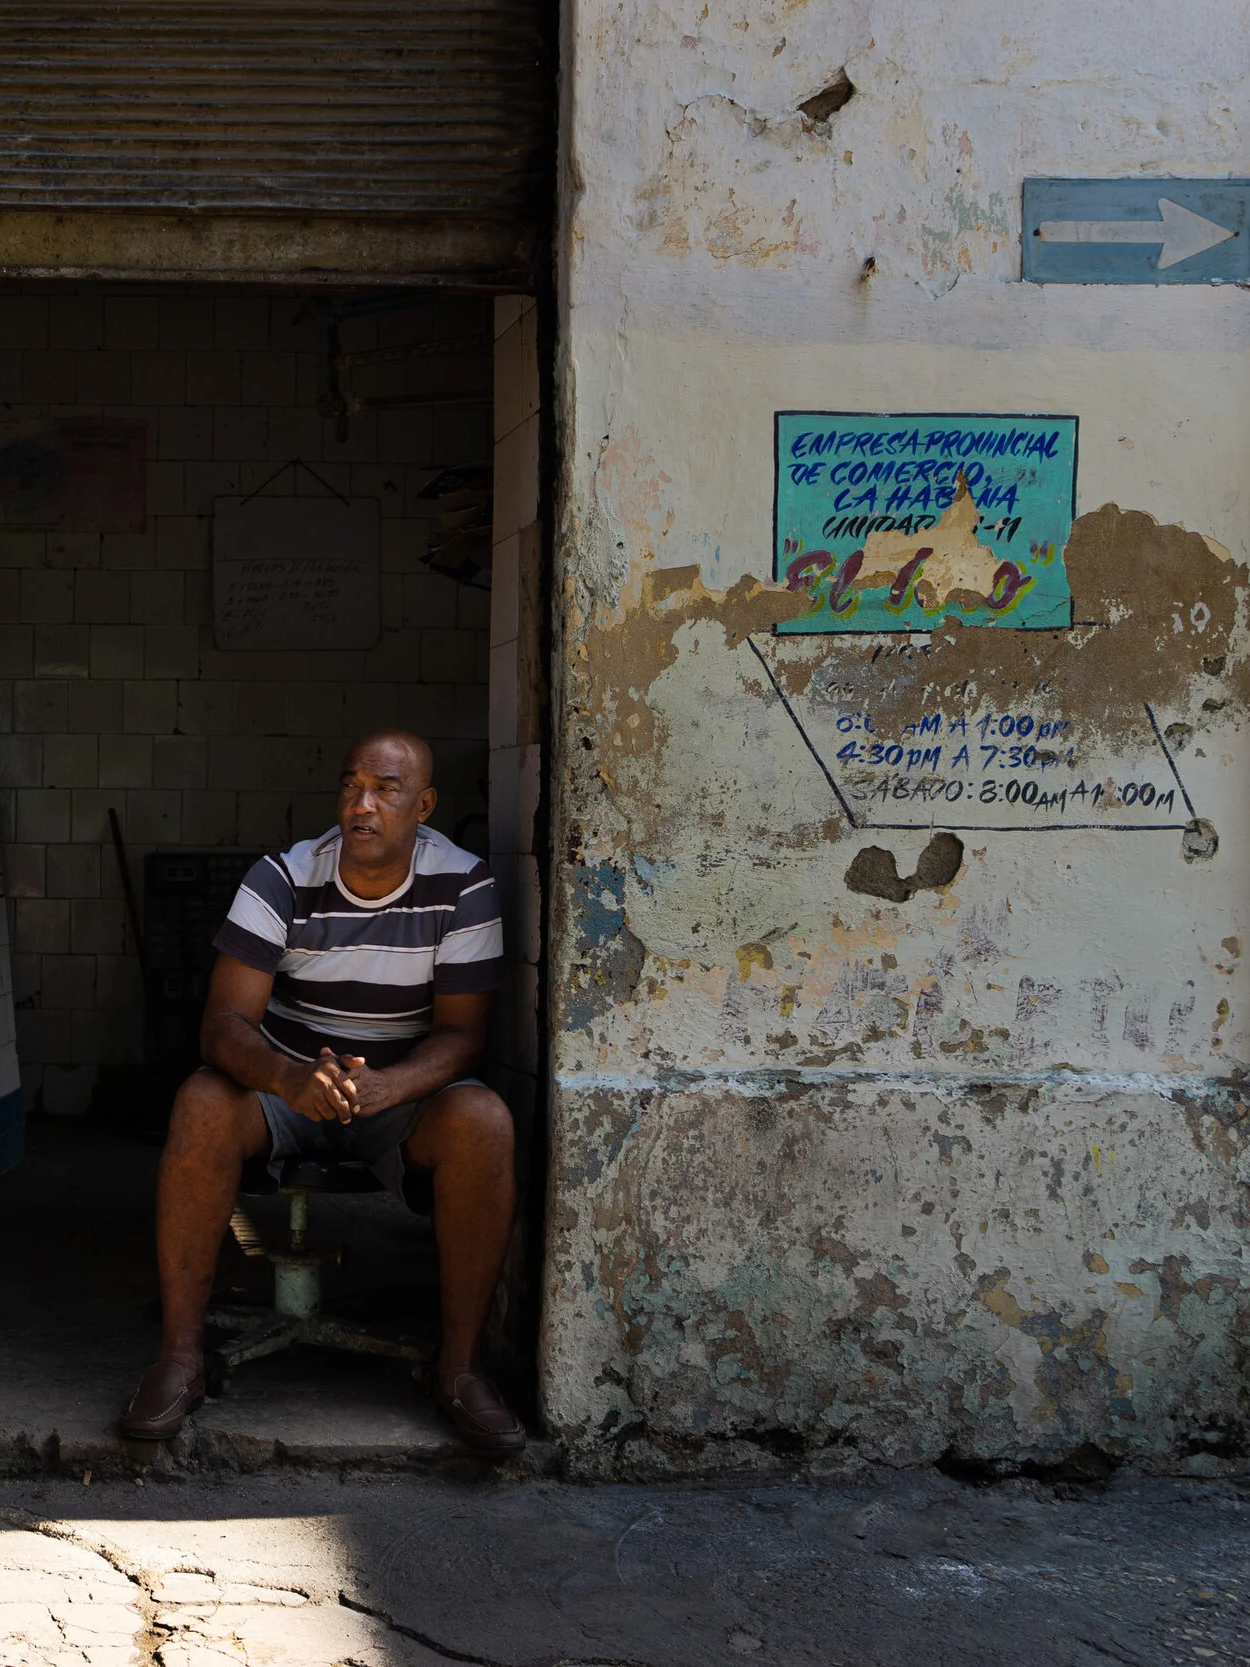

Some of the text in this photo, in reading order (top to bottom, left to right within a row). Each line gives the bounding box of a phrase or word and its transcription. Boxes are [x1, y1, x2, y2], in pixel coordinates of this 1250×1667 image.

[791, 428, 1060, 464] EMPRESA PROVINCIAL
[786, 462, 827, 486] DE
[834, 483, 1019, 515] LA HABNA
[951, 744, 969, 772] A
